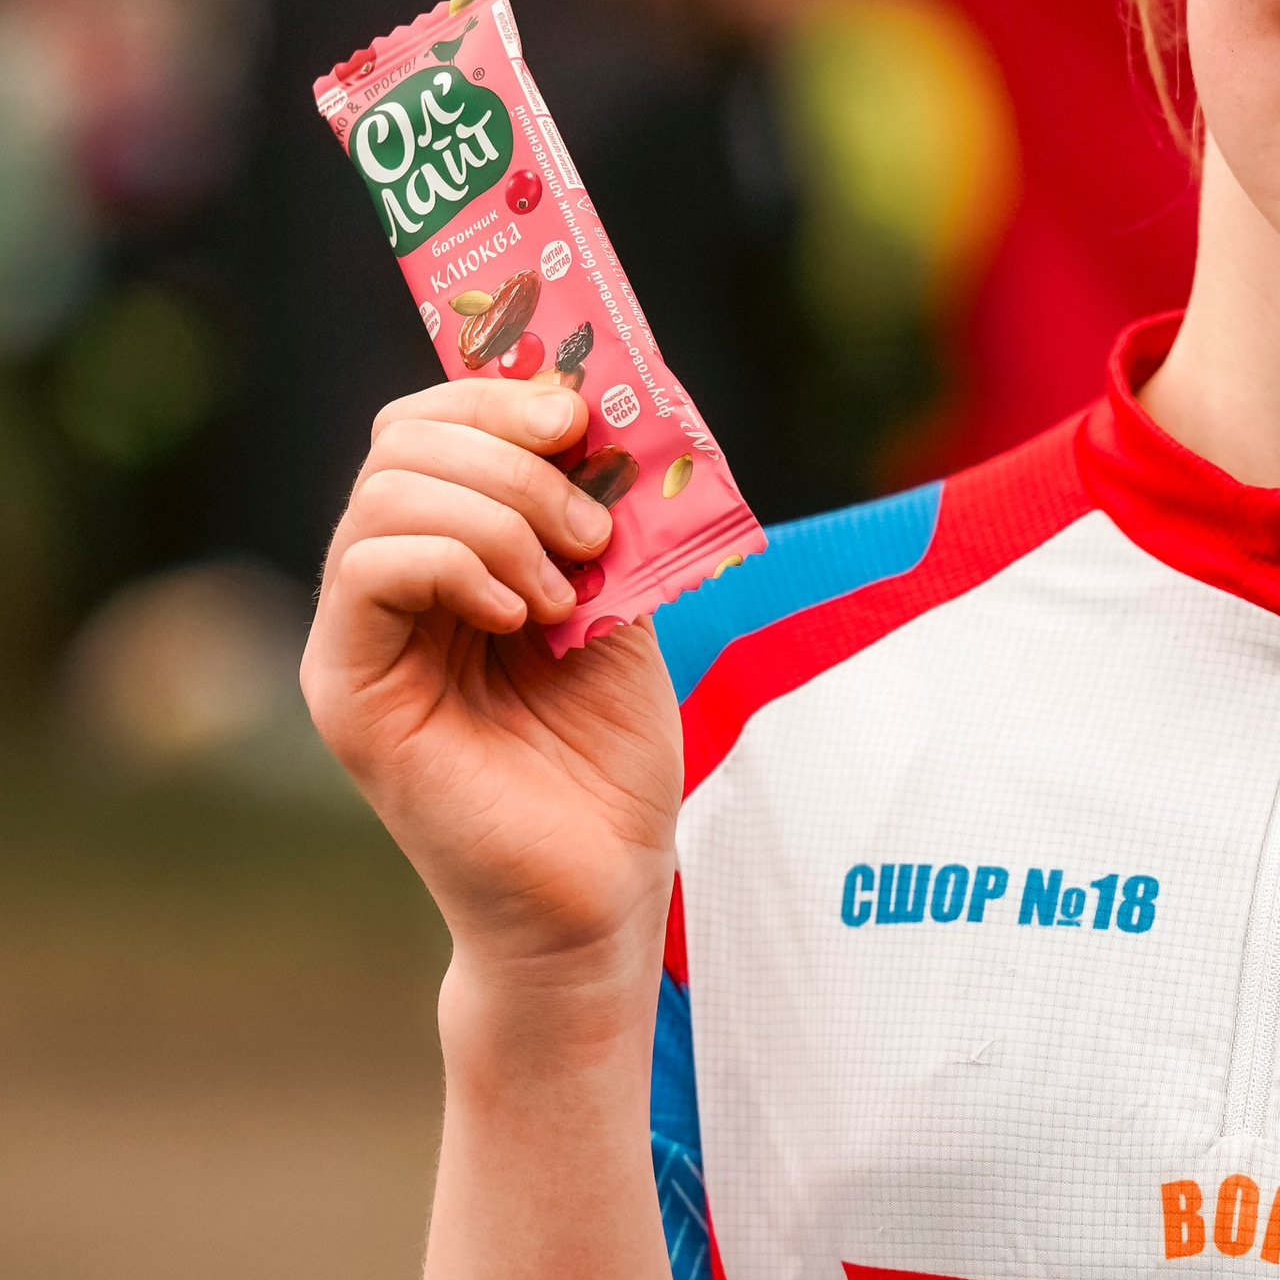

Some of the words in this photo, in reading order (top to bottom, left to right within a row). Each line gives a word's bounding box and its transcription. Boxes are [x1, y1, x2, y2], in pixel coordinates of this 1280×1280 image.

[347, 102, 362, 115] &
[363, 56, 418, 103] ПРОСТО!
[510, 105, 564, 199] клюквенный
[542, 119, 562, 154] ЦЕННОСТЬ
[431, 209, 500, 258] батончик
[542, 242, 565, 265] ЧИТАЙ
[558, 199, 597, 269] батончик
[545, 254, 571, 279] СОСТАВ
[586, 270, 675, 418] фруктово-ореховый
[840, 863, 1009, 928] СШОР
[1017, 868, 1160, 934] №18
